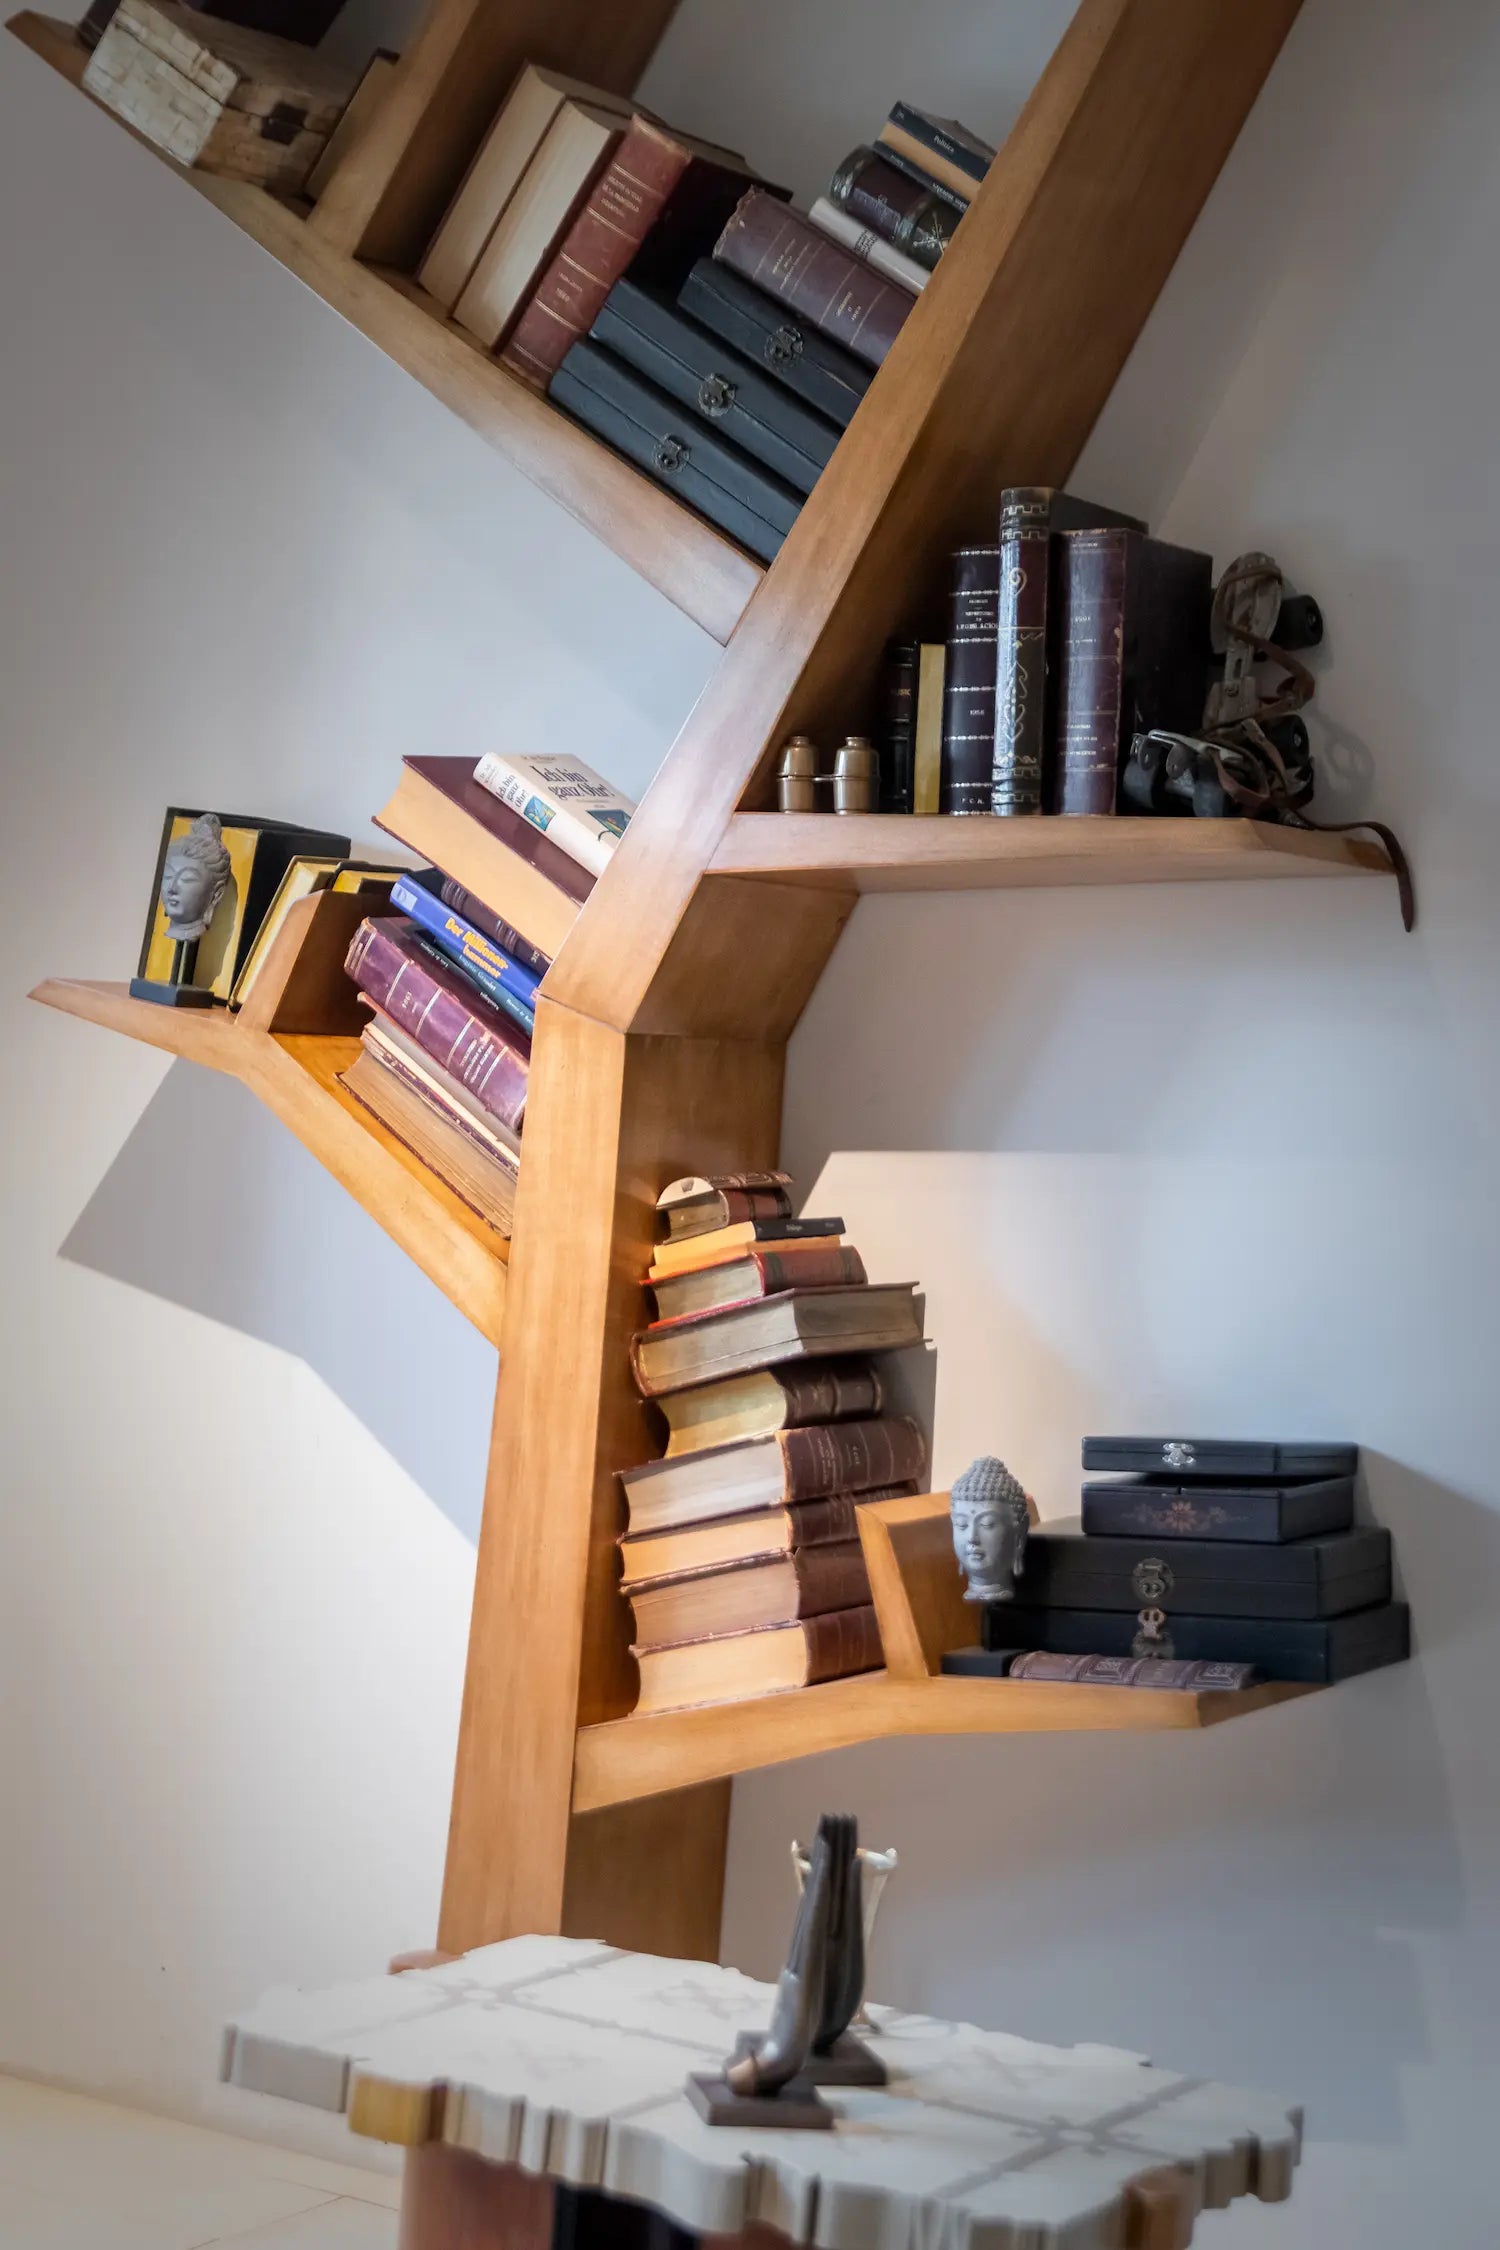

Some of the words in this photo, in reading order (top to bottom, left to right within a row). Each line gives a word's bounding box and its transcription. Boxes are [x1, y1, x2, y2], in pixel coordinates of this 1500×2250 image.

[529, 765, 562, 782] Ich
[555, 767, 588, 782] bin
[495, 786, 507, 800] Ich
[502, 774, 516, 787] bin
[507, 783, 519, 803] ganz
[548, 785, 580, 801] ganz
[577, 783, 616, 798] Ohr!
[444, 917, 464, 937] Der
